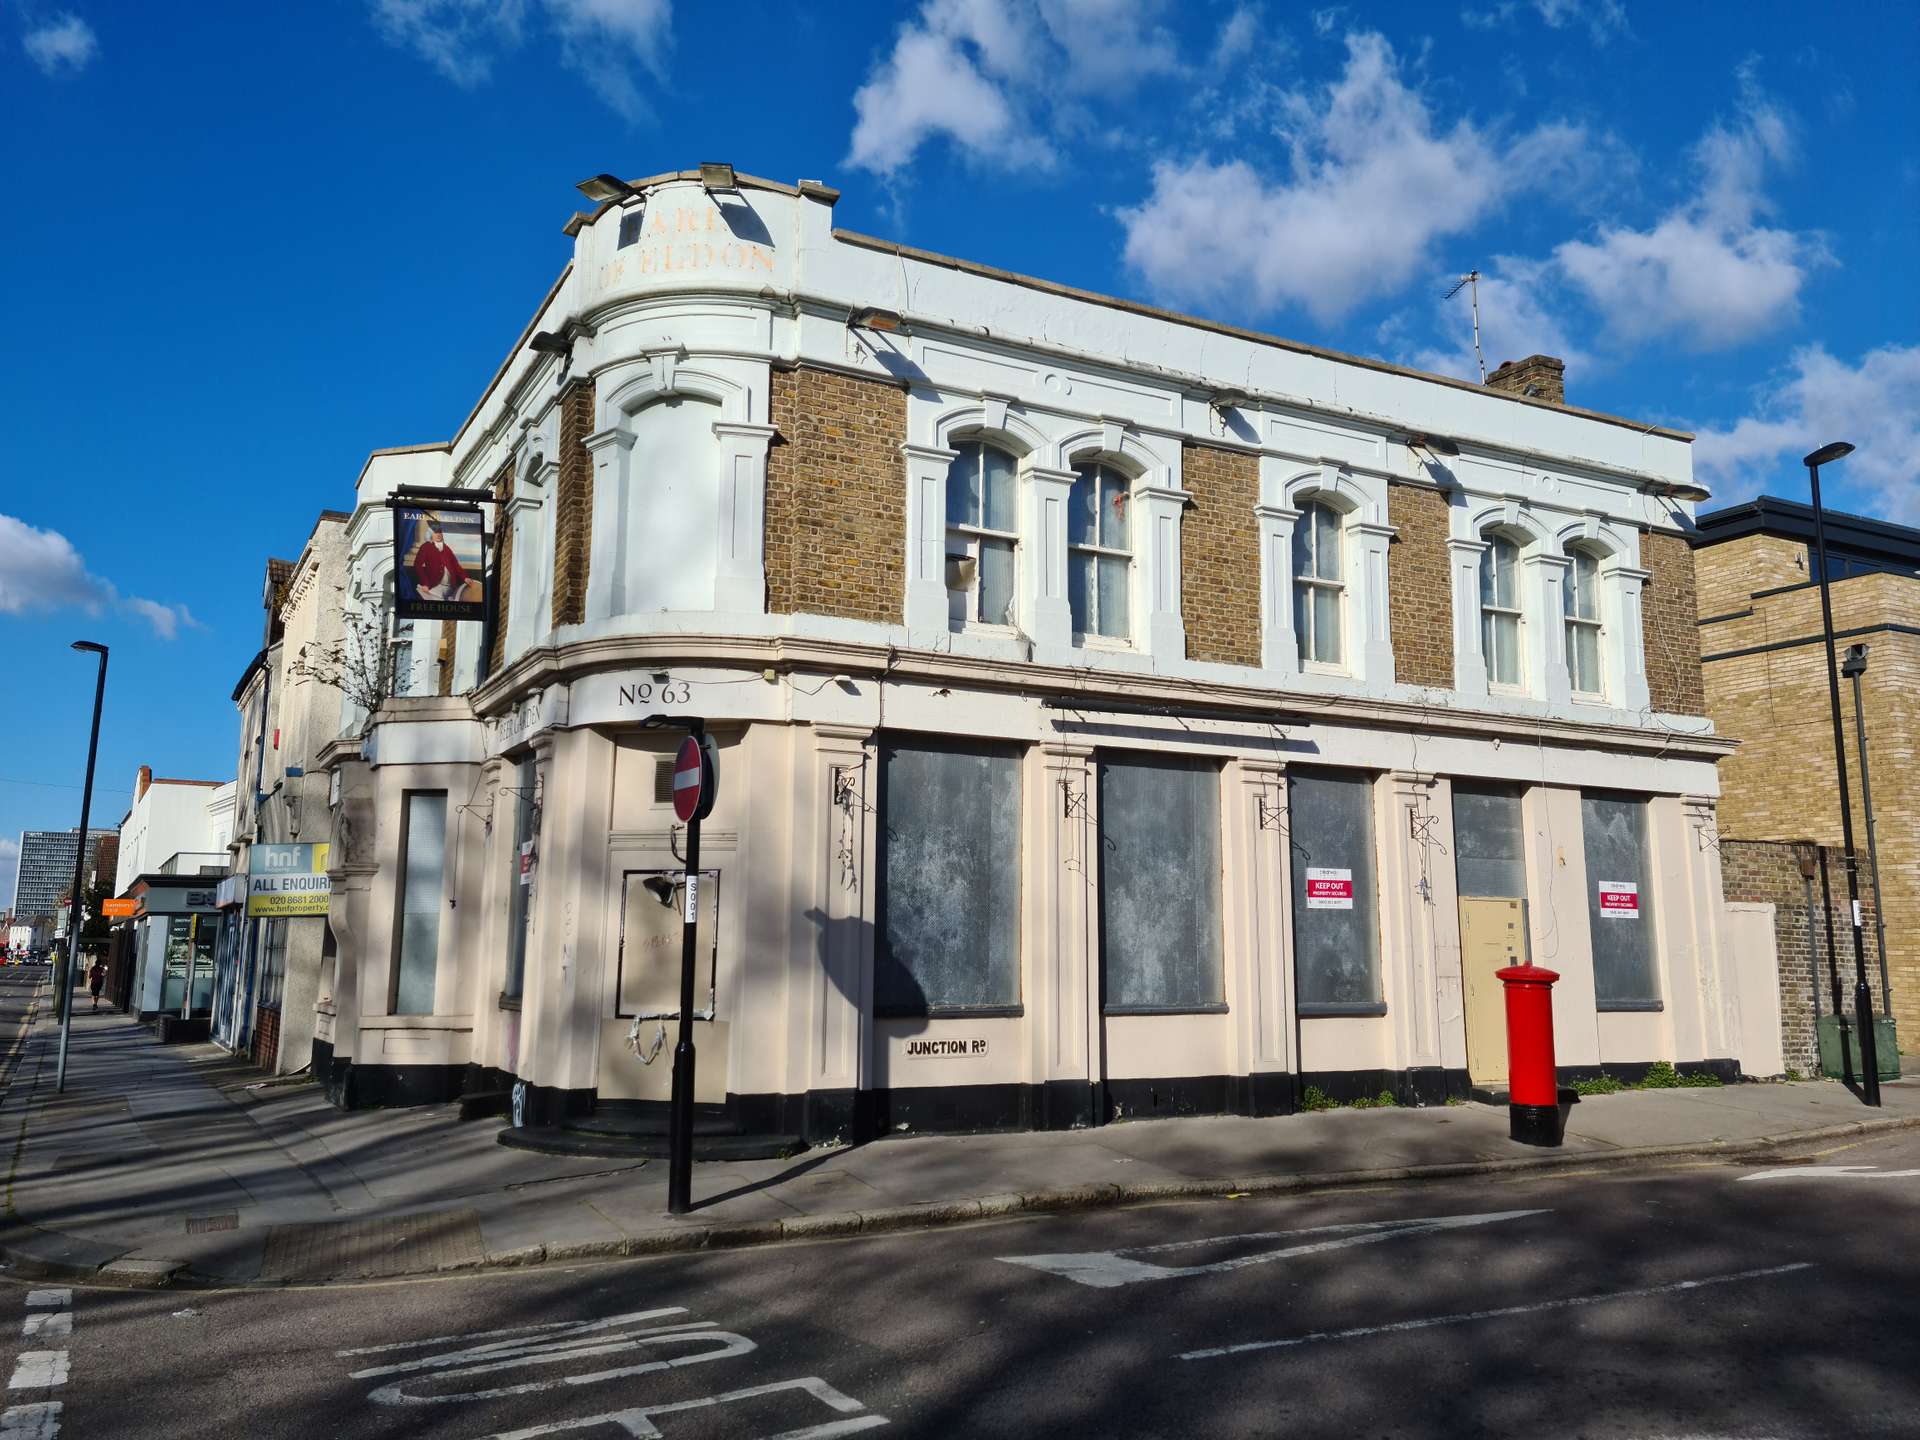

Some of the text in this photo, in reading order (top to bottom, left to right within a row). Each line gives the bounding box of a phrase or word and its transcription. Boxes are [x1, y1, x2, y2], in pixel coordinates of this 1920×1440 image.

[661, 682, 691, 704] 63
[265, 846, 301, 867] hnf
[253, 878, 278, 891] ALL
[1315, 882, 1344, 890] KEEP OUT
[270, 896, 286, 905] 020
[907, 1041, 967, 1055] JUNCTION
